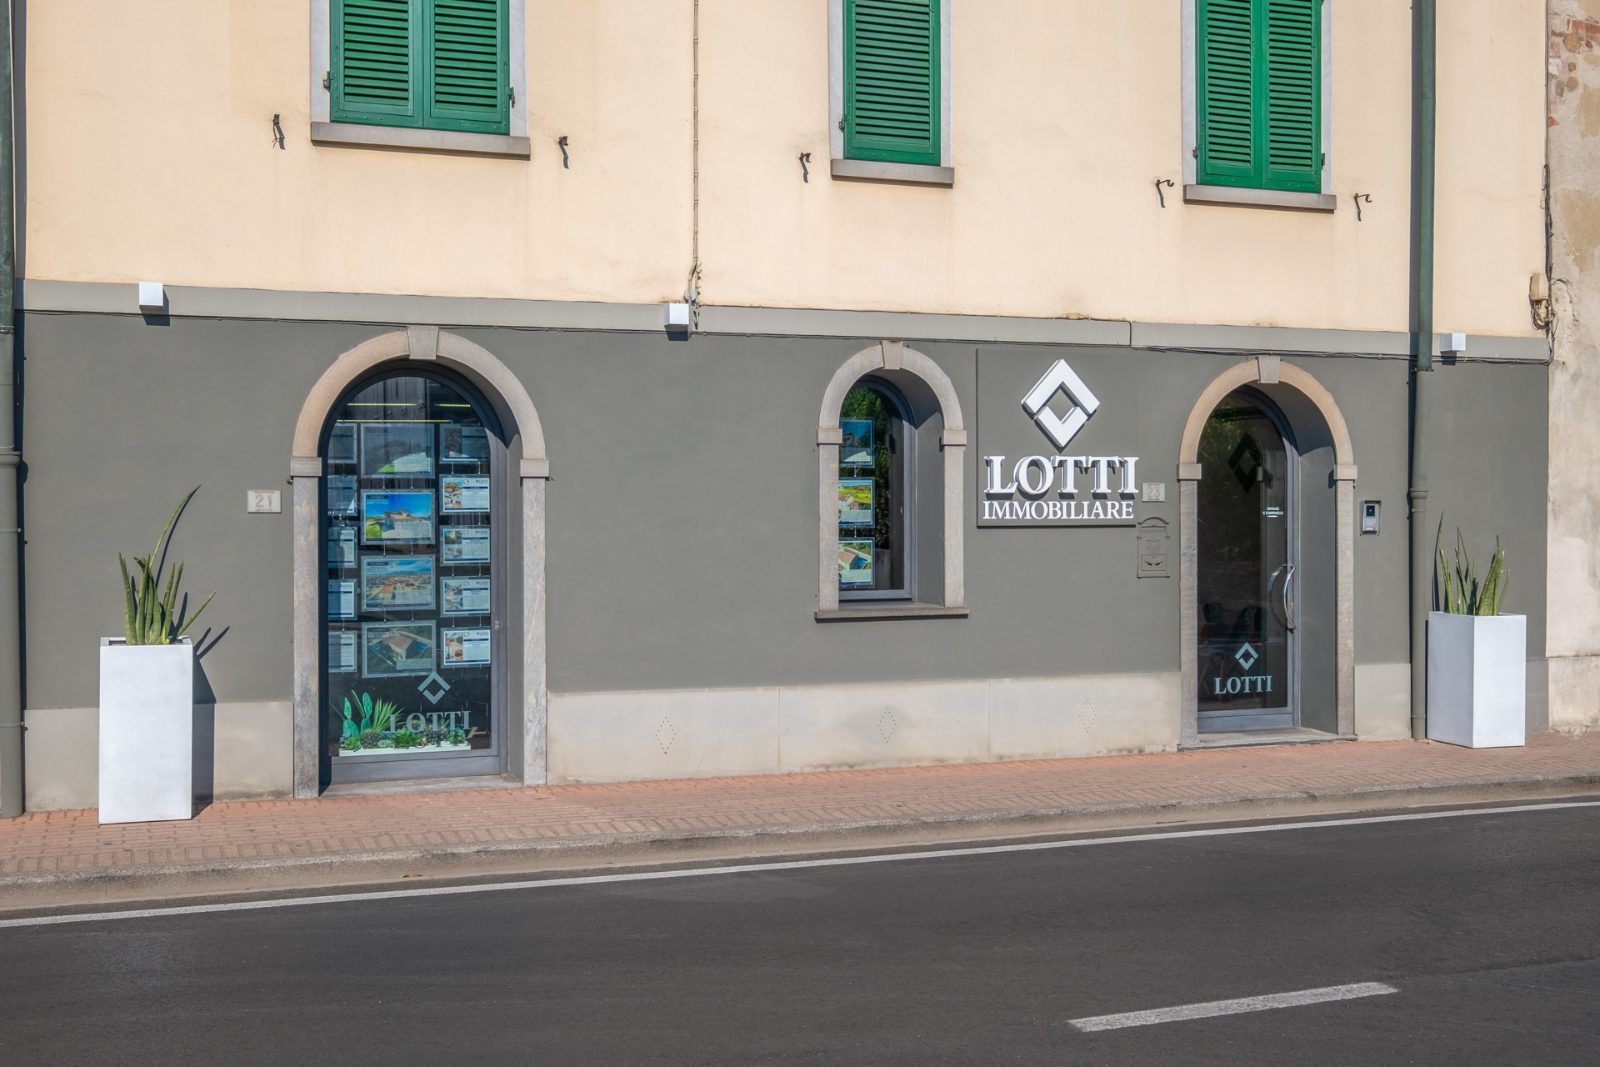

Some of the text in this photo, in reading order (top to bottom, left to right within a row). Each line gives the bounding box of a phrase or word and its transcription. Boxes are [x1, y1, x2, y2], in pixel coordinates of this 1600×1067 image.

[983, 455, 1140, 494] LOTTI
[256, 494, 272, 508] 21
[983, 501, 1134, 520] IMMOBILIARE
[1214, 675, 1273, 695] LOTTI
